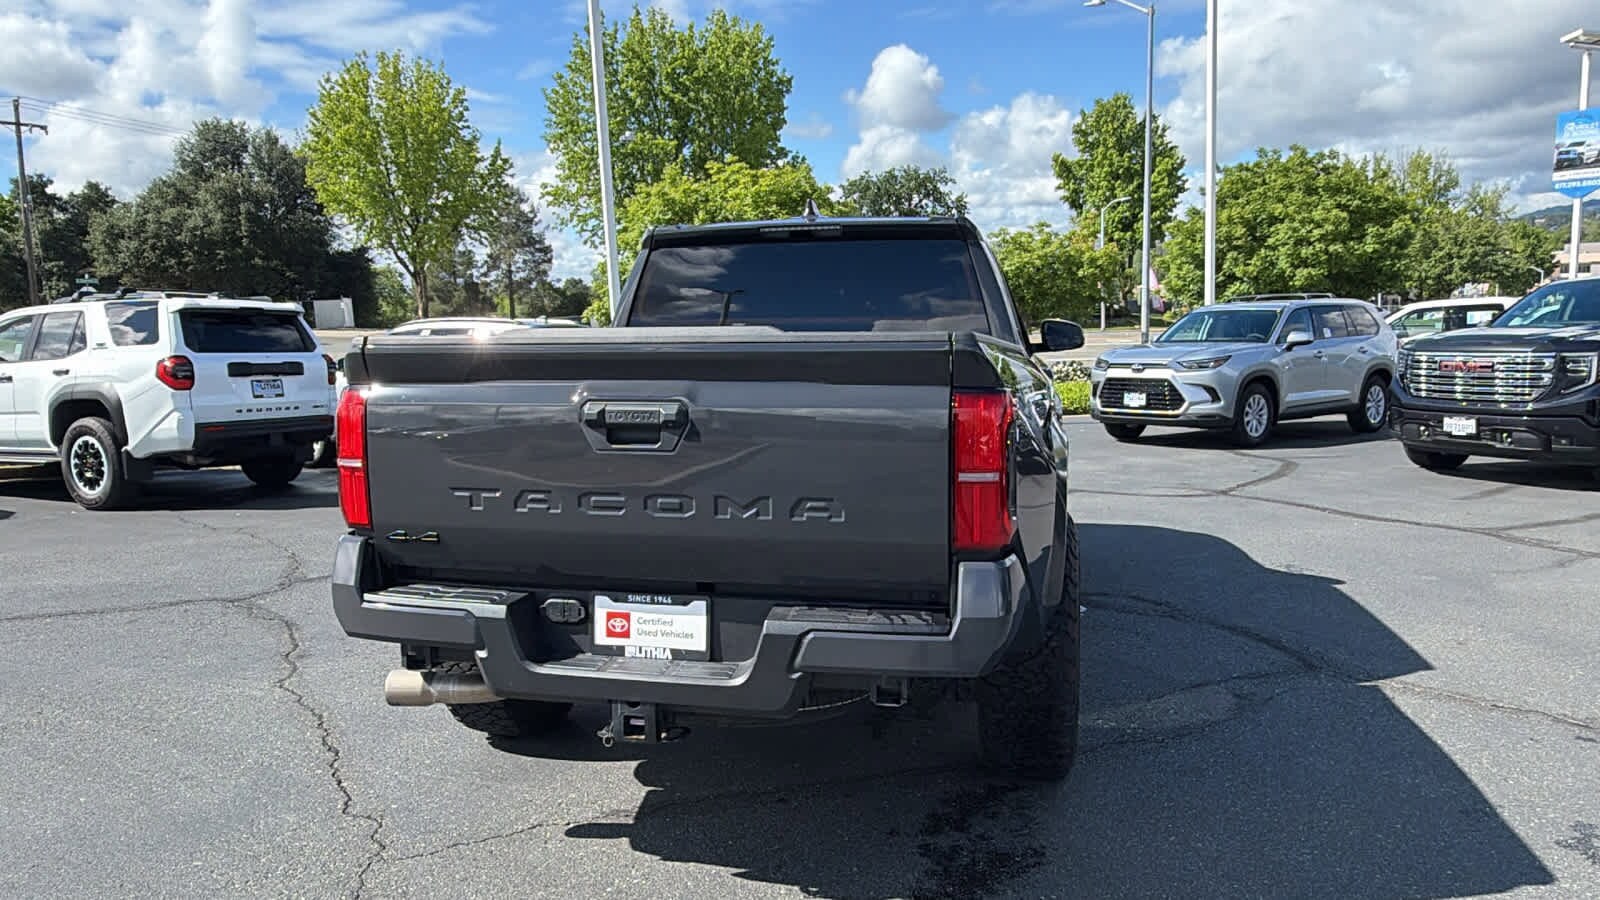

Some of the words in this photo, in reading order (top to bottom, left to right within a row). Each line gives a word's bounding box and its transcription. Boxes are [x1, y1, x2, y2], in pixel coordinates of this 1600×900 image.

[1440, 361, 1493, 372] GMC
[607, 410, 657, 423] TOYOTA
[450, 487, 846, 522] TACOMA
[627, 594, 651, 603] SINCE
[636, 616, 674, 627] Certified
[636, 627, 658, 637] Used
[660, 630, 694, 639] Vehicles
[635, 646, 672, 660] LITHIA
